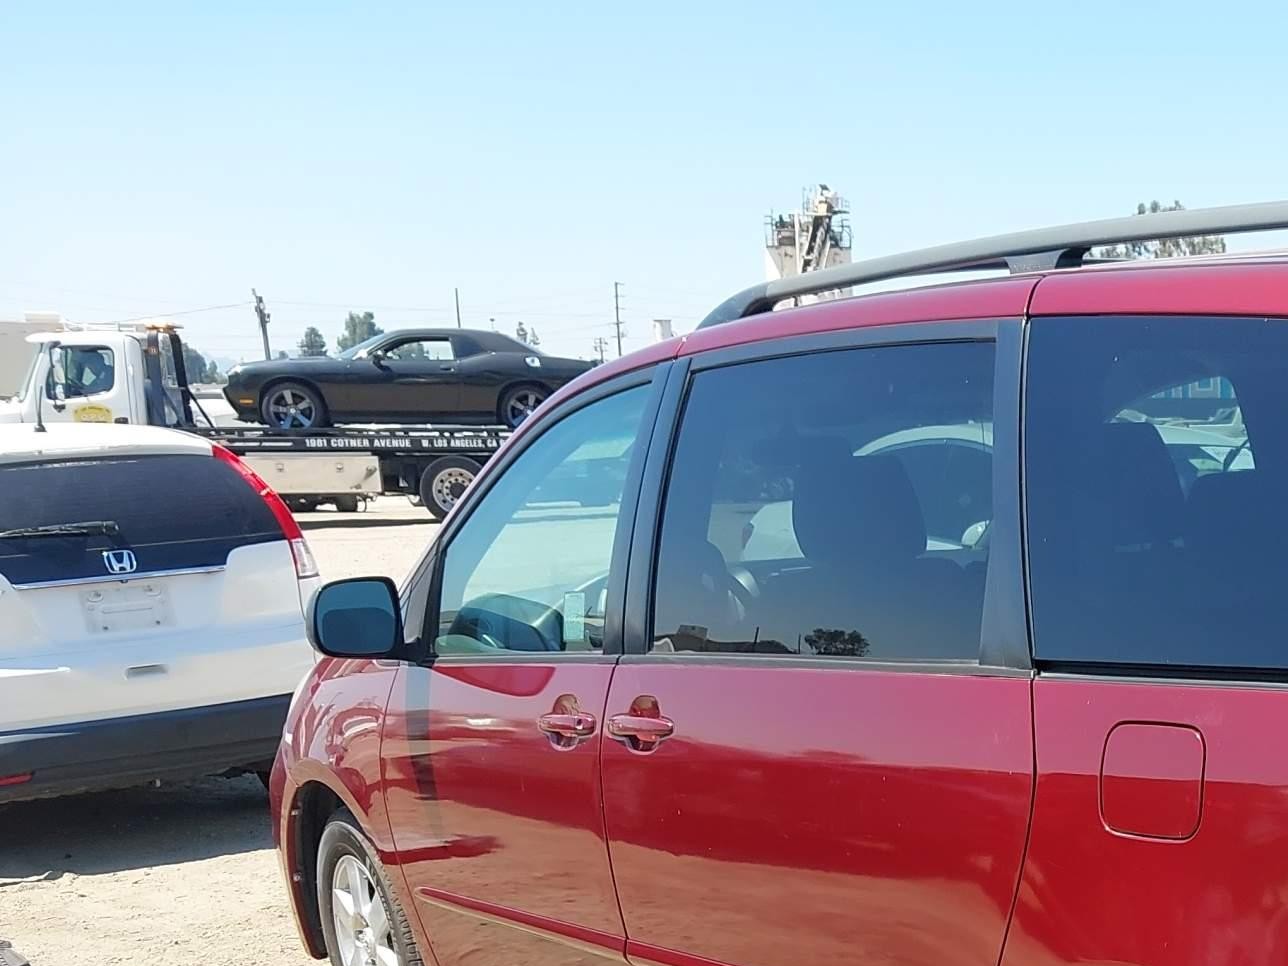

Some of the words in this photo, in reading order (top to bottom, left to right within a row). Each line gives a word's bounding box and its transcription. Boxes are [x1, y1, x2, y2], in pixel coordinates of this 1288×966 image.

[373, 438, 411, 447] AVENUE
[433, 438, 448, 447] LOS
[450, 438, 485, 448] ANGELES,
[487, 438, 497, 447] CA
